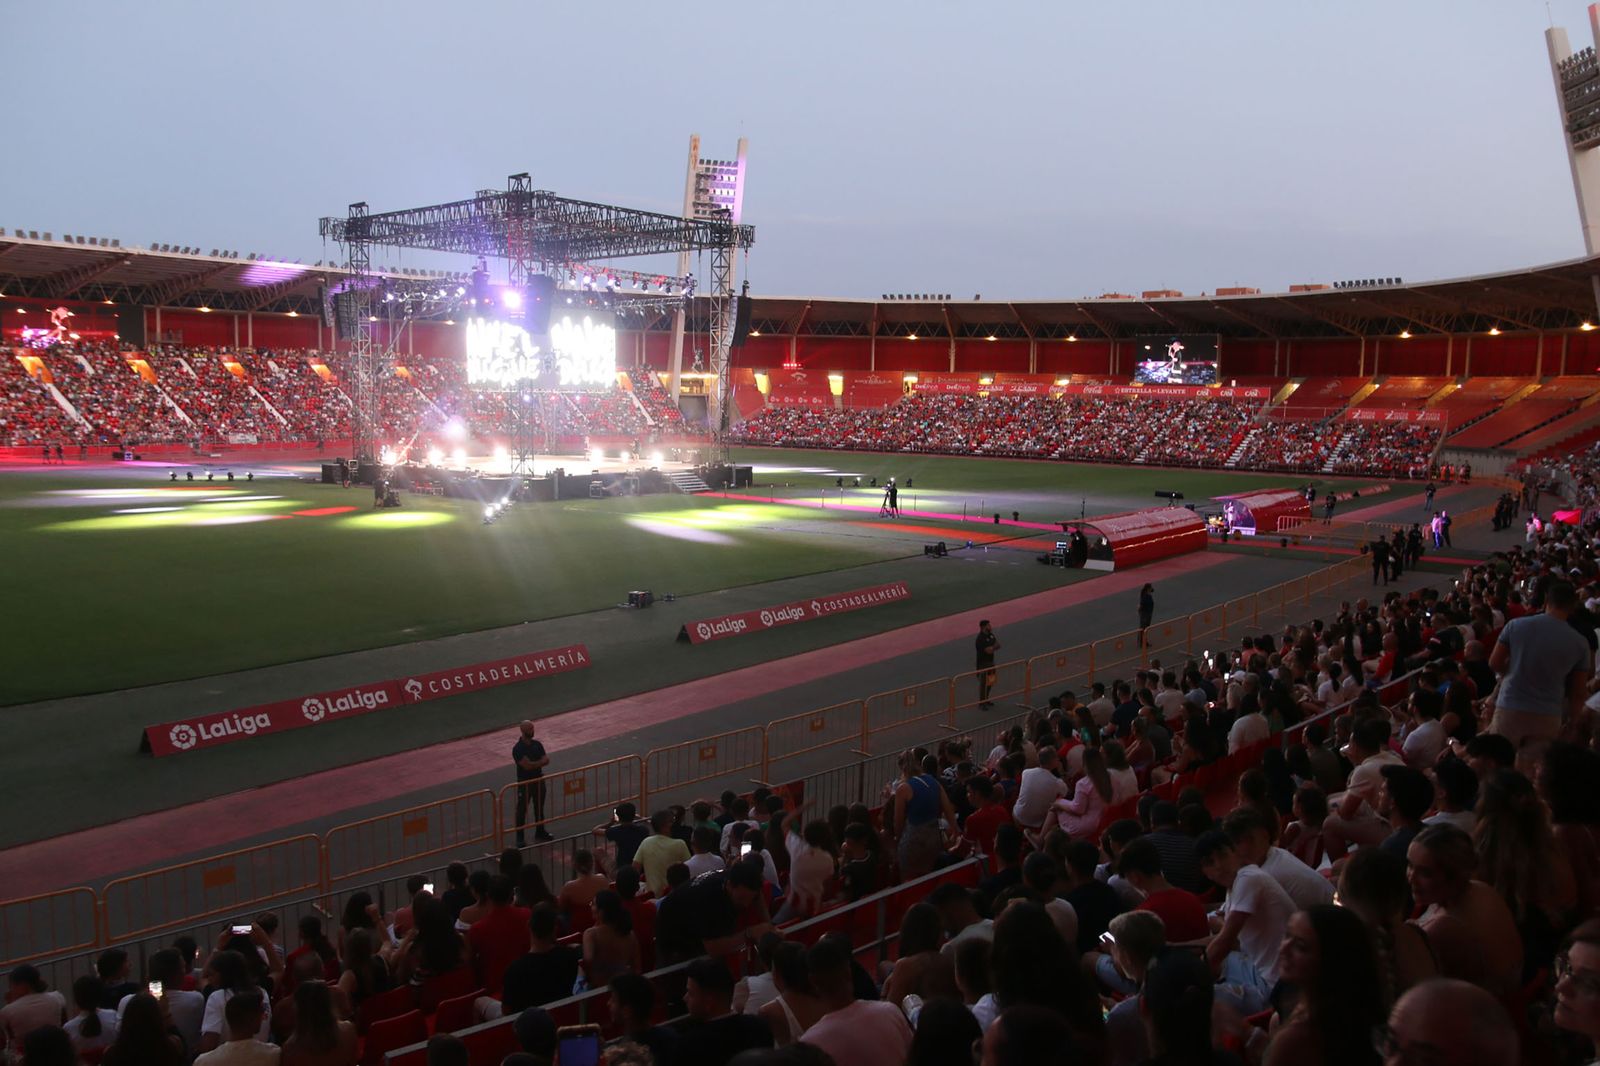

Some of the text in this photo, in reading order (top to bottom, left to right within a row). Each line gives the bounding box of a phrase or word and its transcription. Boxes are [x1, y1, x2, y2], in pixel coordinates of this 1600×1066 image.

[710, 618, 747, 635] LaLiga
[773, 605, 805, 622] LaLiga
[197, 649, 587, 742] LaLiga LaLiga COSTADEALMERÍA
